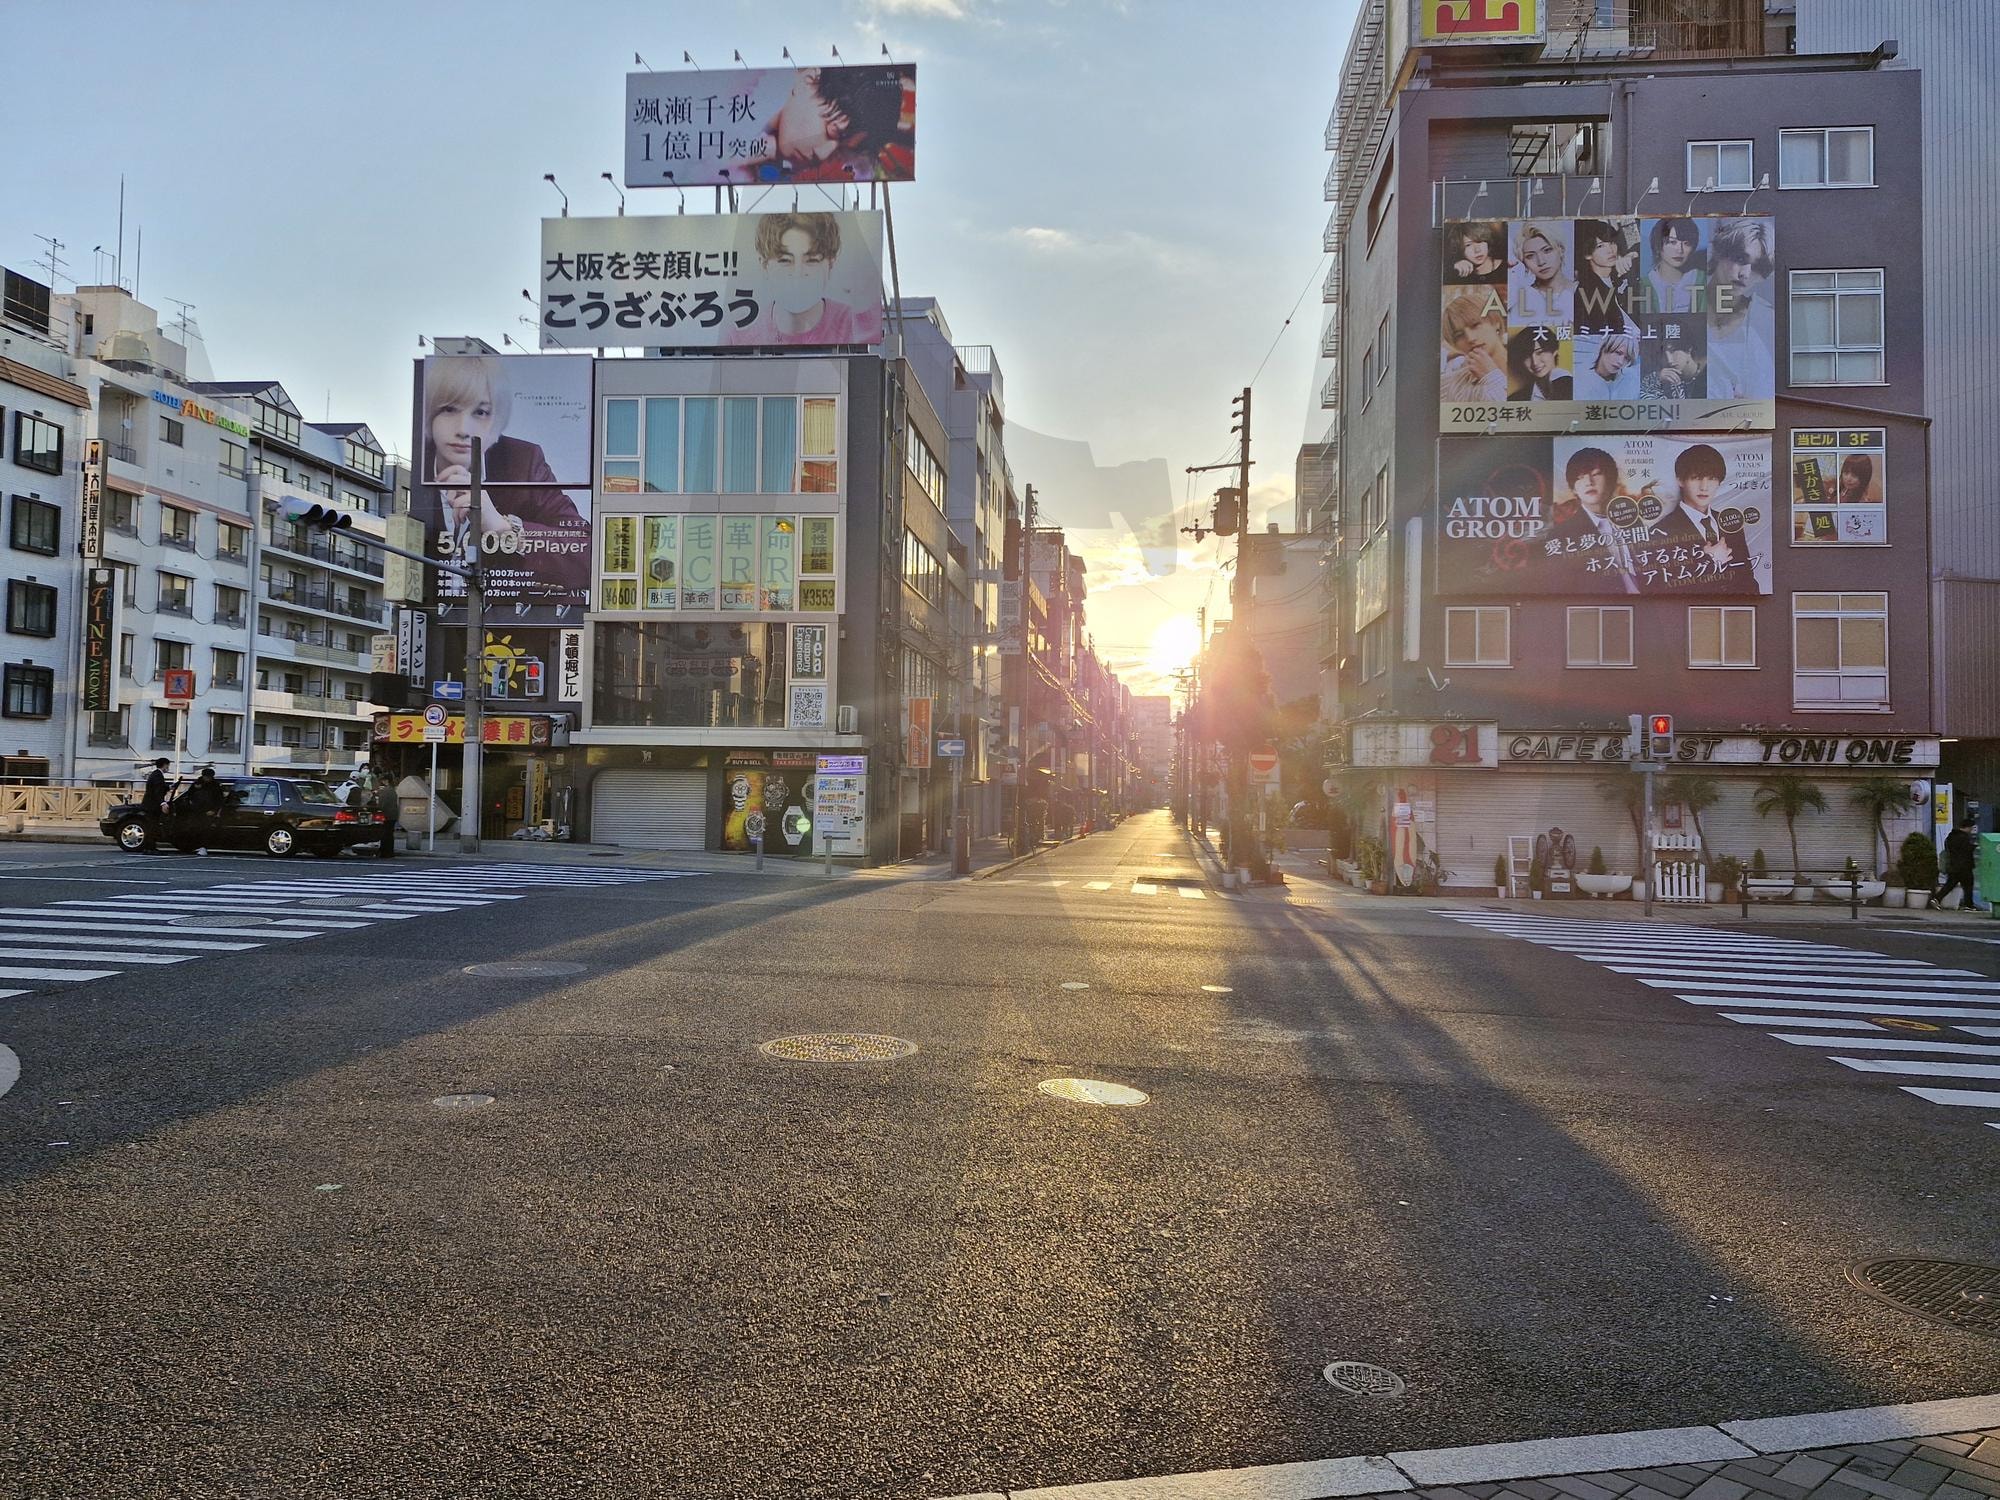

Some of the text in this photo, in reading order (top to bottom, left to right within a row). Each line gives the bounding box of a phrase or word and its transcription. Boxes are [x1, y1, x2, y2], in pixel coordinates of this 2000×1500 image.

[545, 250, 738, 281] 大阪を笑顔に!!
[543, 289, 760, 330] こうざぶろう
[1480, 284, 1734, 318] ALL WHITE
[1533, 323, 1681, 341] 大阪ミナミ上陸
[1450, 403, 1680, 423] 2023年秋 遂にOPEN!
[1624, 440, 1653, 449] ATOM
[1797, 433, 1870, 446] 当ビル 3F
[1735, 453, 1764, 461] ATOM
[1446, 496, 1542, 518] ATOM
[1802, 461, 1831, 529] 耳かき 処
[1446, 520, 1544, 538] GROUP
[1544, 526, 1668, 557] 愛と夢の空間へ
[606, 588, 637, 605] ¥6600
[803, 588, 834, 606] ¥3553
[89, 587, 108, 658] FINE
[565, 633, 580, 697] 道頓堀ビル
[813, 628, 824, 673] Tea
[88, 659, 101, 709] AROMA
[1430, 725, 1483, 764] 21
[1509, 736, 1598, 760] CAFE
[1601, 736, 1626, 760] &
[1759, 739, 1838, 763] TONI
[1845, 739, 1916, 763] ONE
